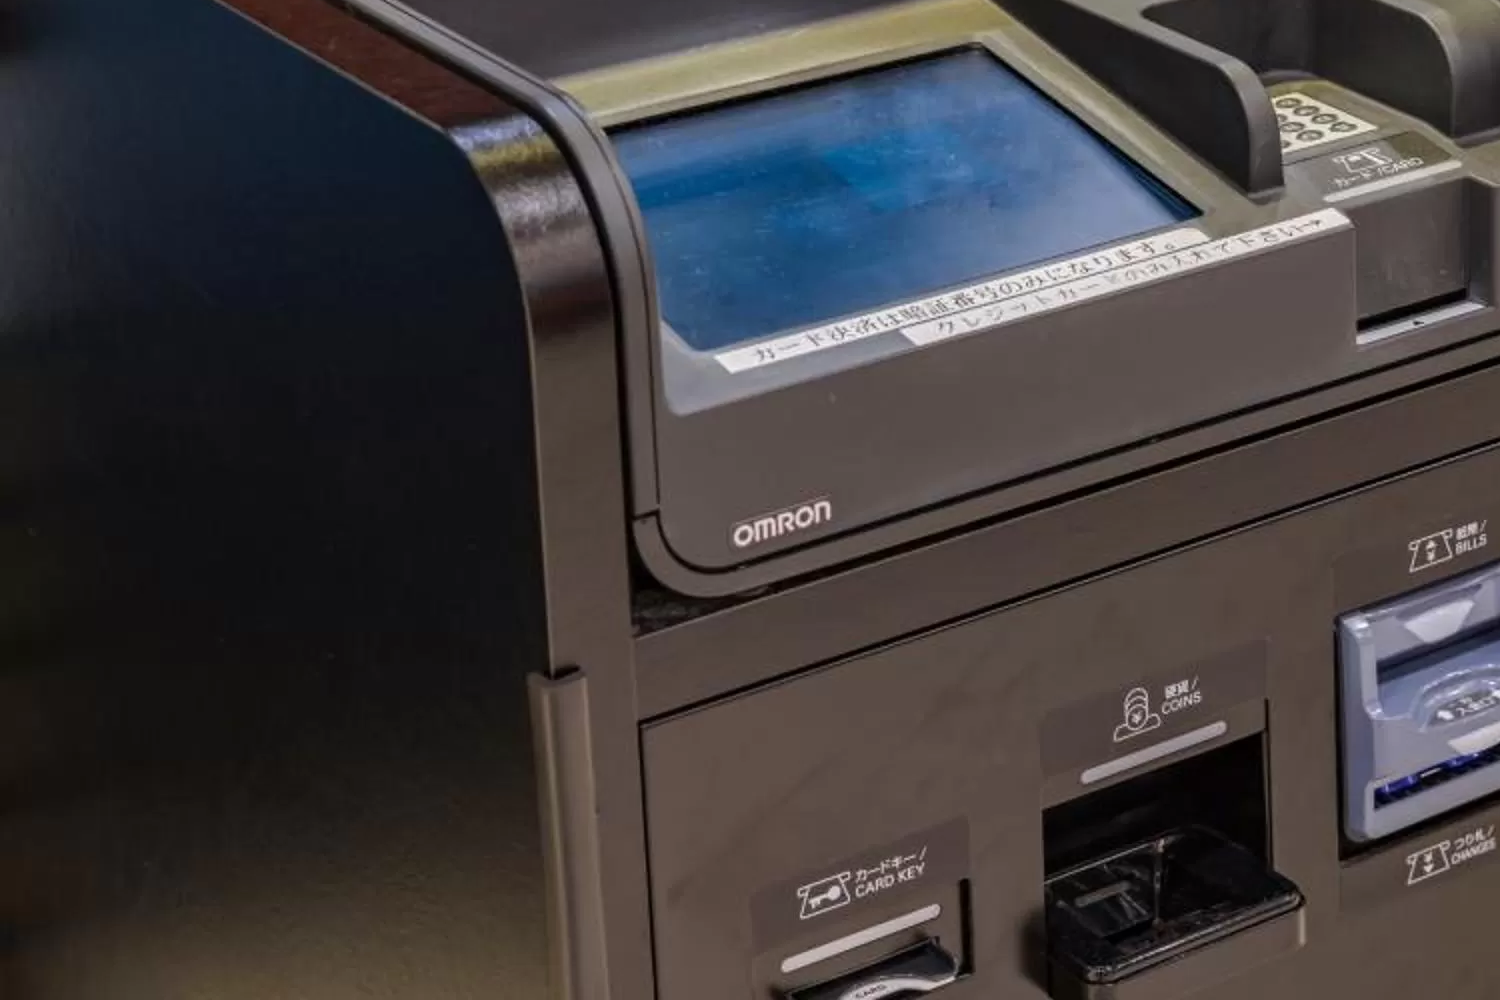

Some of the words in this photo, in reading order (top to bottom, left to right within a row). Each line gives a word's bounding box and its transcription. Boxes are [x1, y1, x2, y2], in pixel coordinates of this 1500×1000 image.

[1161, 691, 1203, 715] COINS
[855, 871, 895, 898] CARD
[899, 861, 926, 882] KEY
